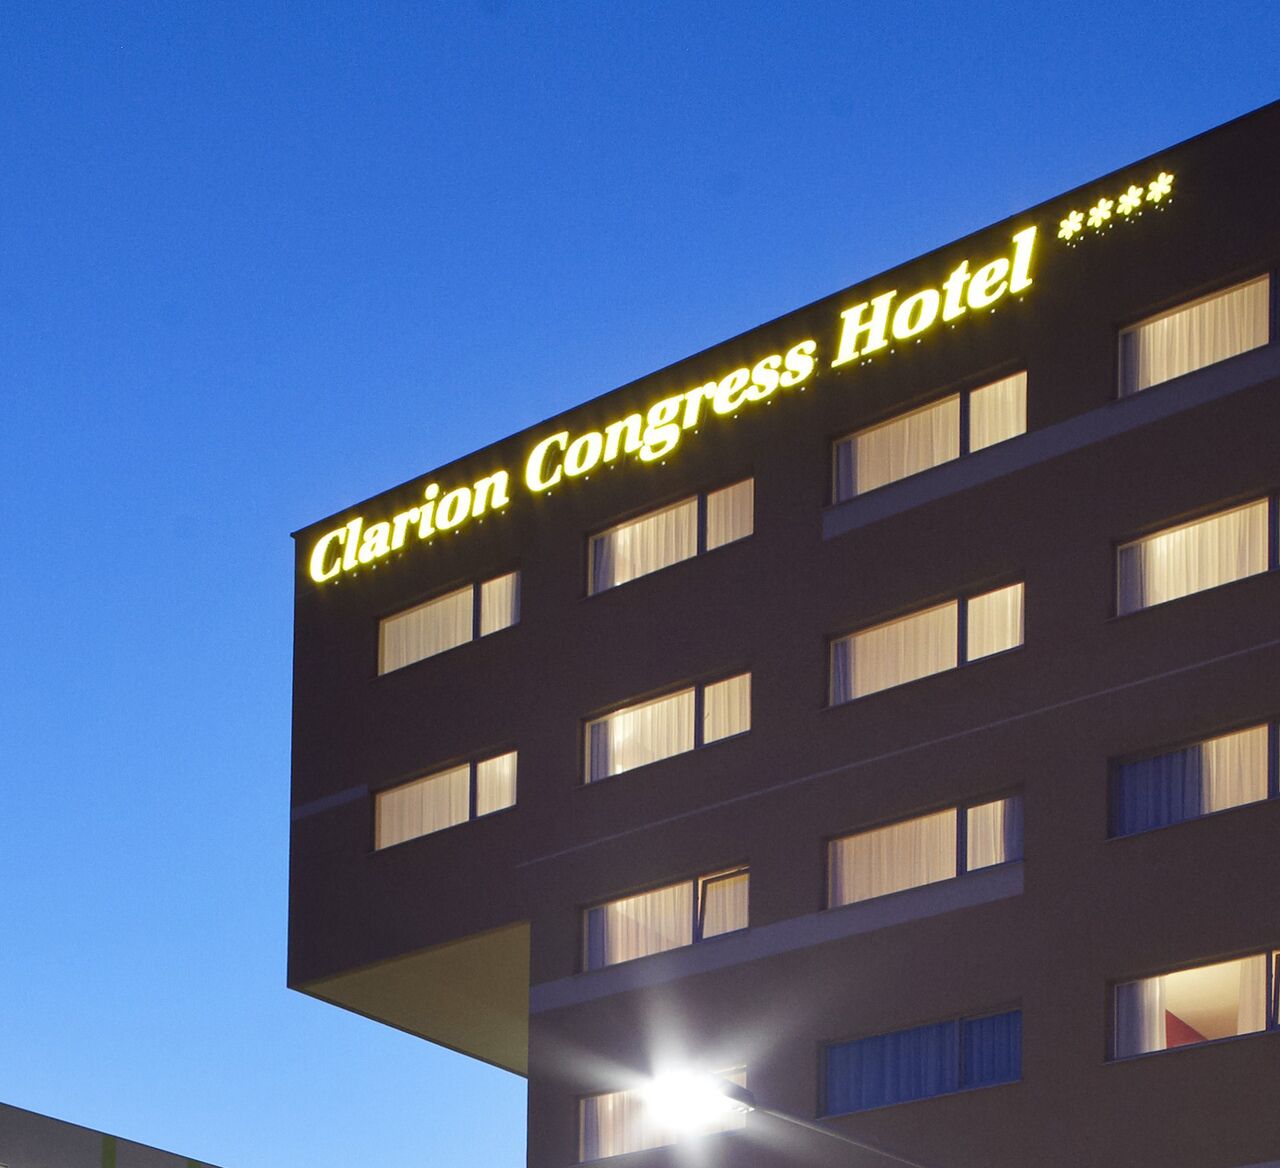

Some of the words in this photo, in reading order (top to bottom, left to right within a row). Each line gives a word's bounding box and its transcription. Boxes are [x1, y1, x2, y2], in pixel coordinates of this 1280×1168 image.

[309, 469, 510, 583] Clarion
[524, 339, 817, 493] Congress
[830, 225, 1038, 369] Hotel
